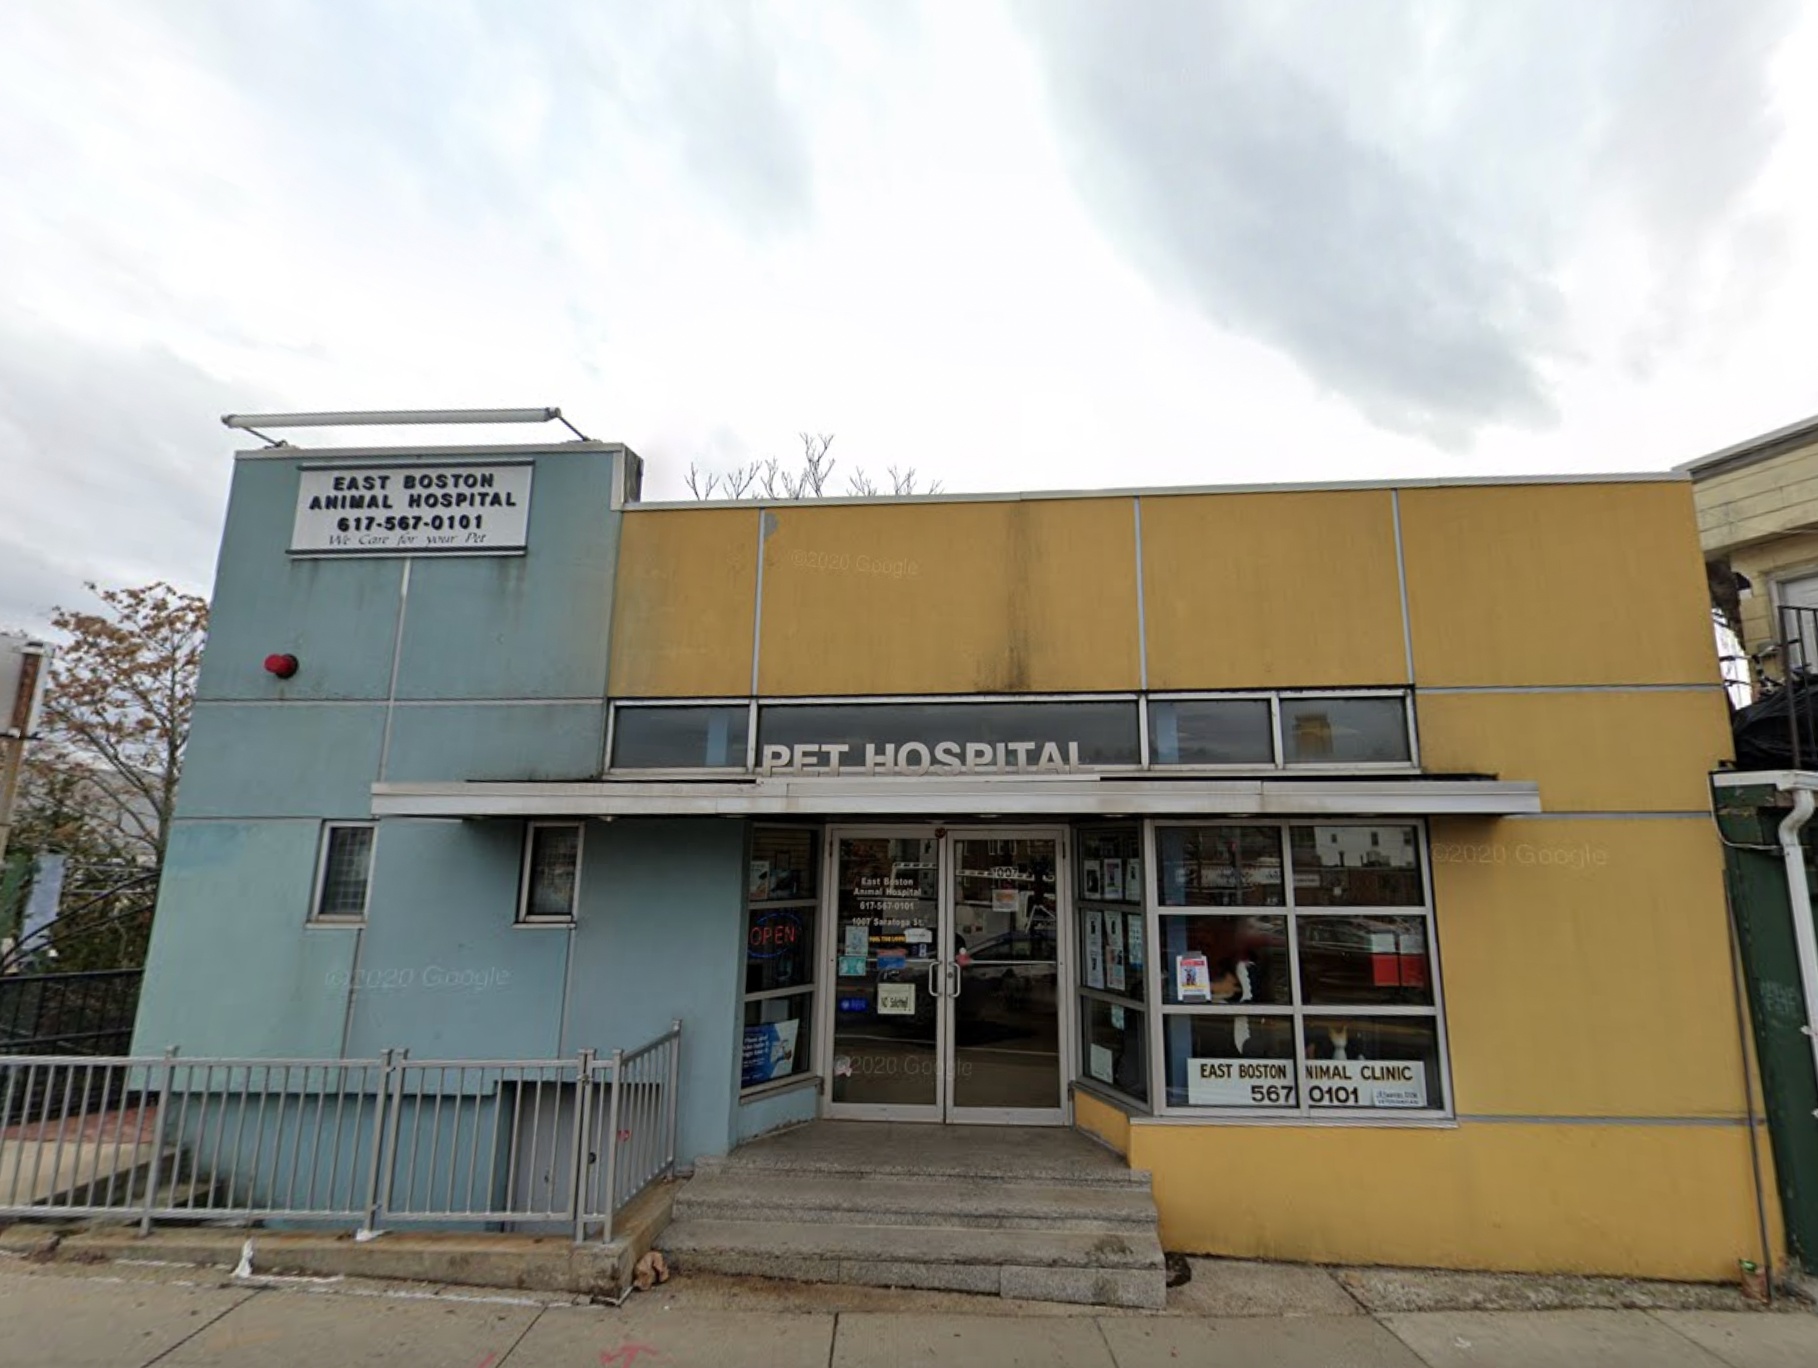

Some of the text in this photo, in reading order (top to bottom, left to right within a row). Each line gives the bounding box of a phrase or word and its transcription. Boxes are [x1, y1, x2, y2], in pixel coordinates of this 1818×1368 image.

[333, 473, 495, 491] EAST BOSTON
[309, 492, 517, 510] ANIMAL HOSPITAL
[337, 514, 483, 532] 617-567-0101
[329, 531, 487, 547] We Care for your Pet
[761, 741, 1095, 777] PET HOSPITAL
[861, 877, 880, 886] East
[853, 888, 922, 897] Animal Hospital
[860, 901, 914, 910] 617-567-0101
[874, 918, 910, 928] Saratoga
[750, 925, 796, 945] OPEN
[1200, 1064, 1413, 1081] EAST BOSTON NIMAL CLINIC
[1251, 1085, 1294, 1102] 567
[1309, 1086, 1359, 1104] 0101
